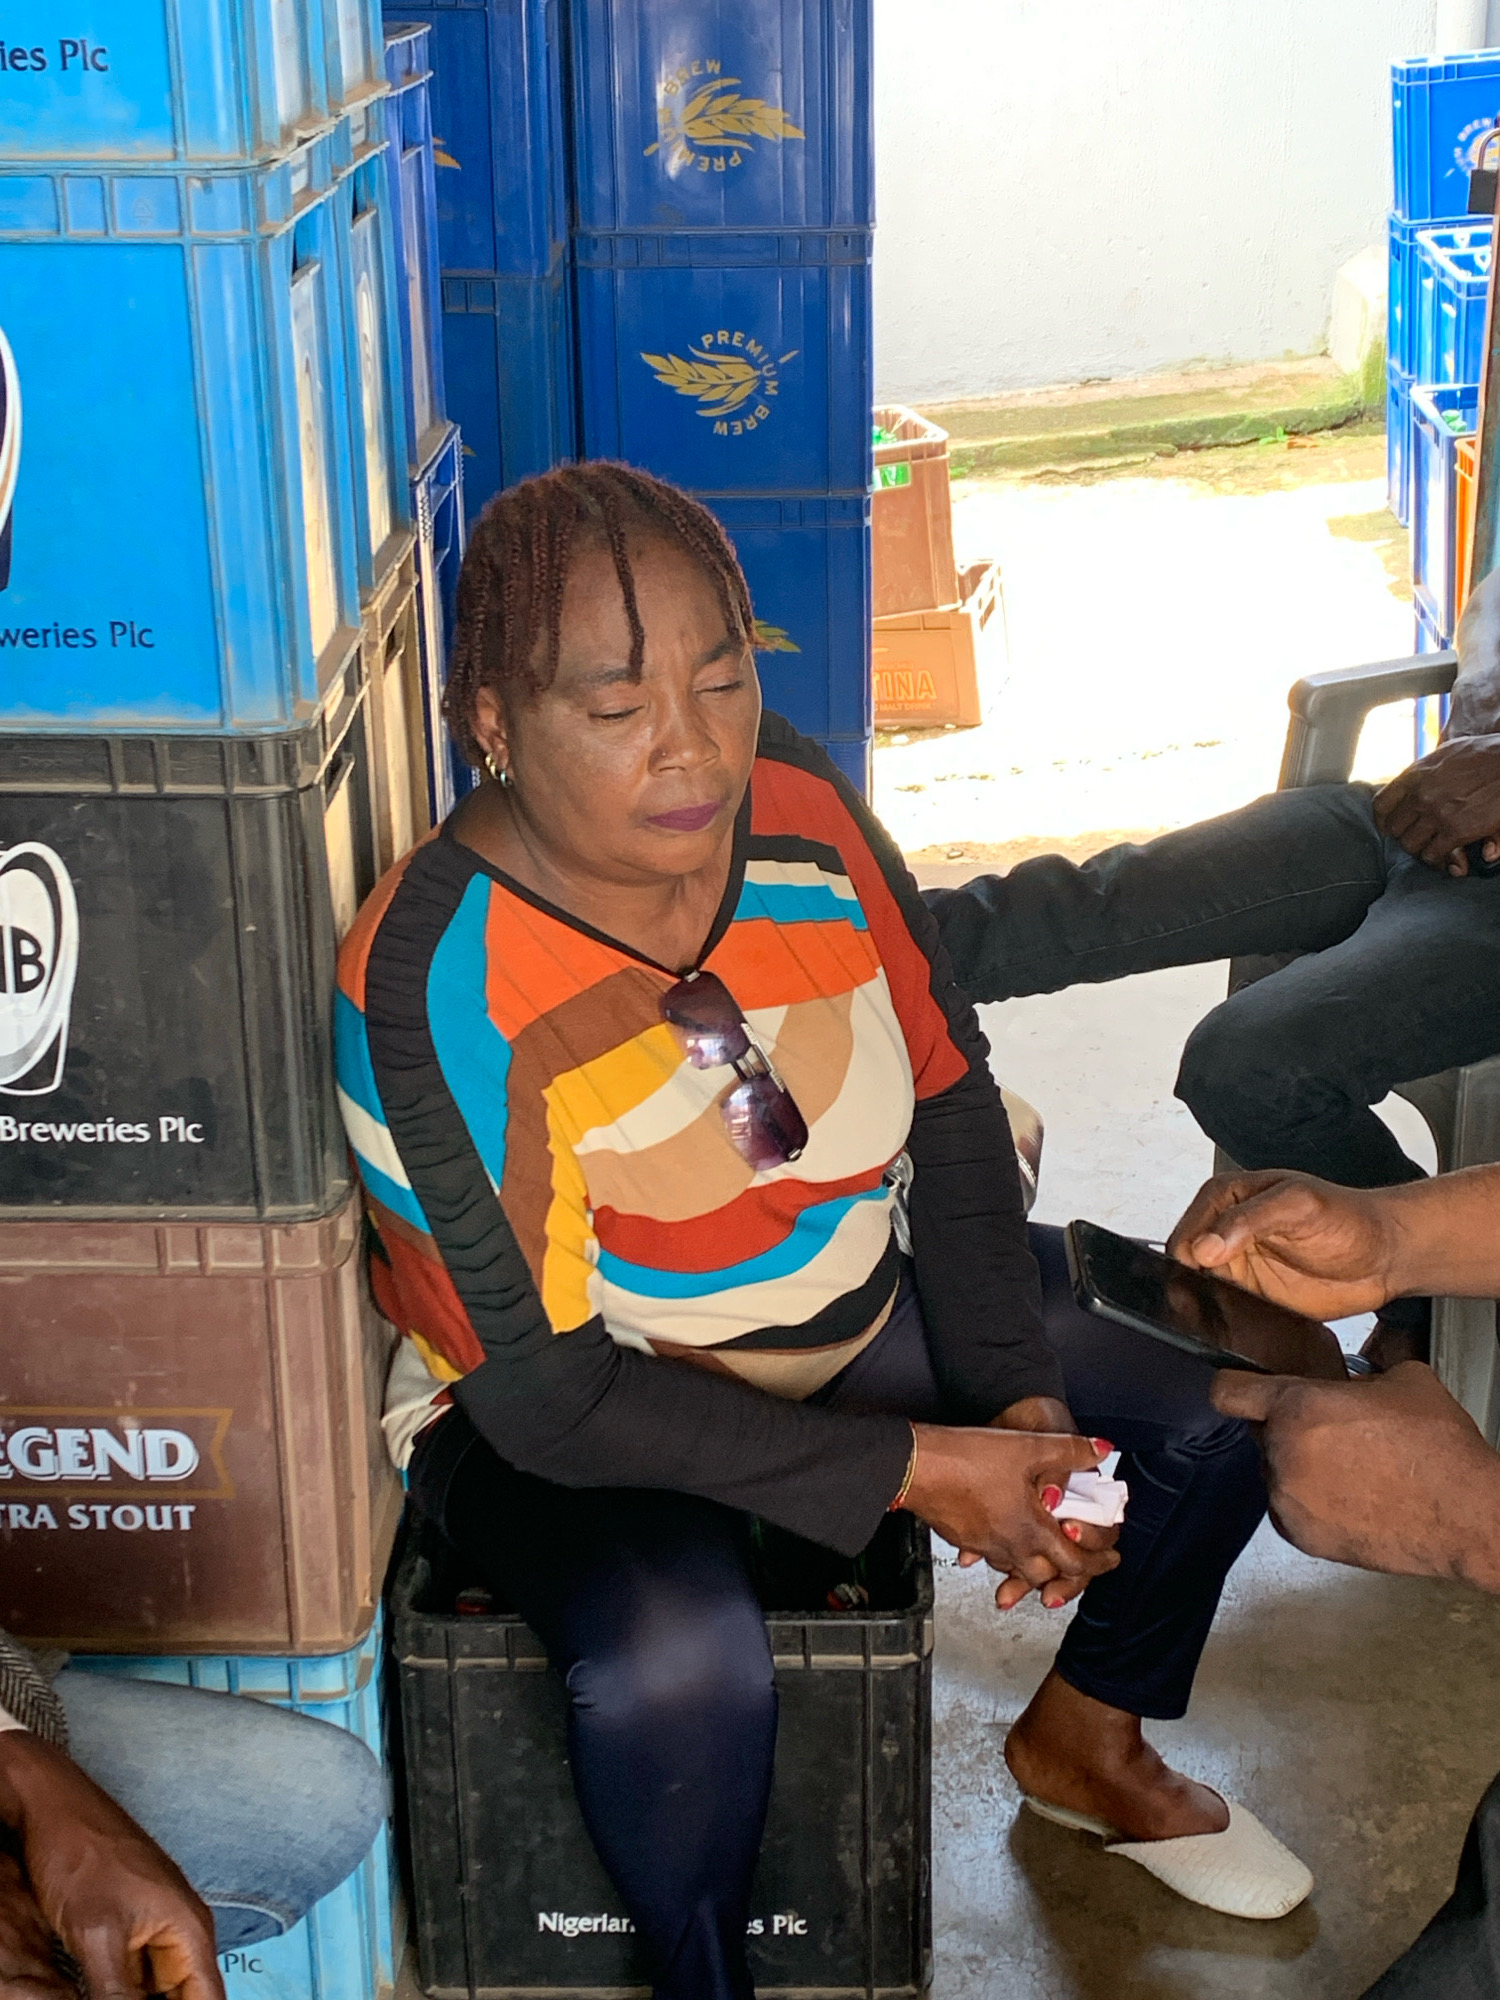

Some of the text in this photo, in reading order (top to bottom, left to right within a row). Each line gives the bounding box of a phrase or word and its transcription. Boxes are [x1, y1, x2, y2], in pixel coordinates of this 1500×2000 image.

[58, 39, 108, 72] Plc
[701, 329, 779, 436] PREMIUM BREW
[0, 620, 155, 649] weries Plc
[0, 1115, 205, 1143] Breweries Plc
[67, 1503, 196, 1531] STOUT
[772, 1914, 808, 1936] Plc
[224, 1952, 264, 1974] Plc
